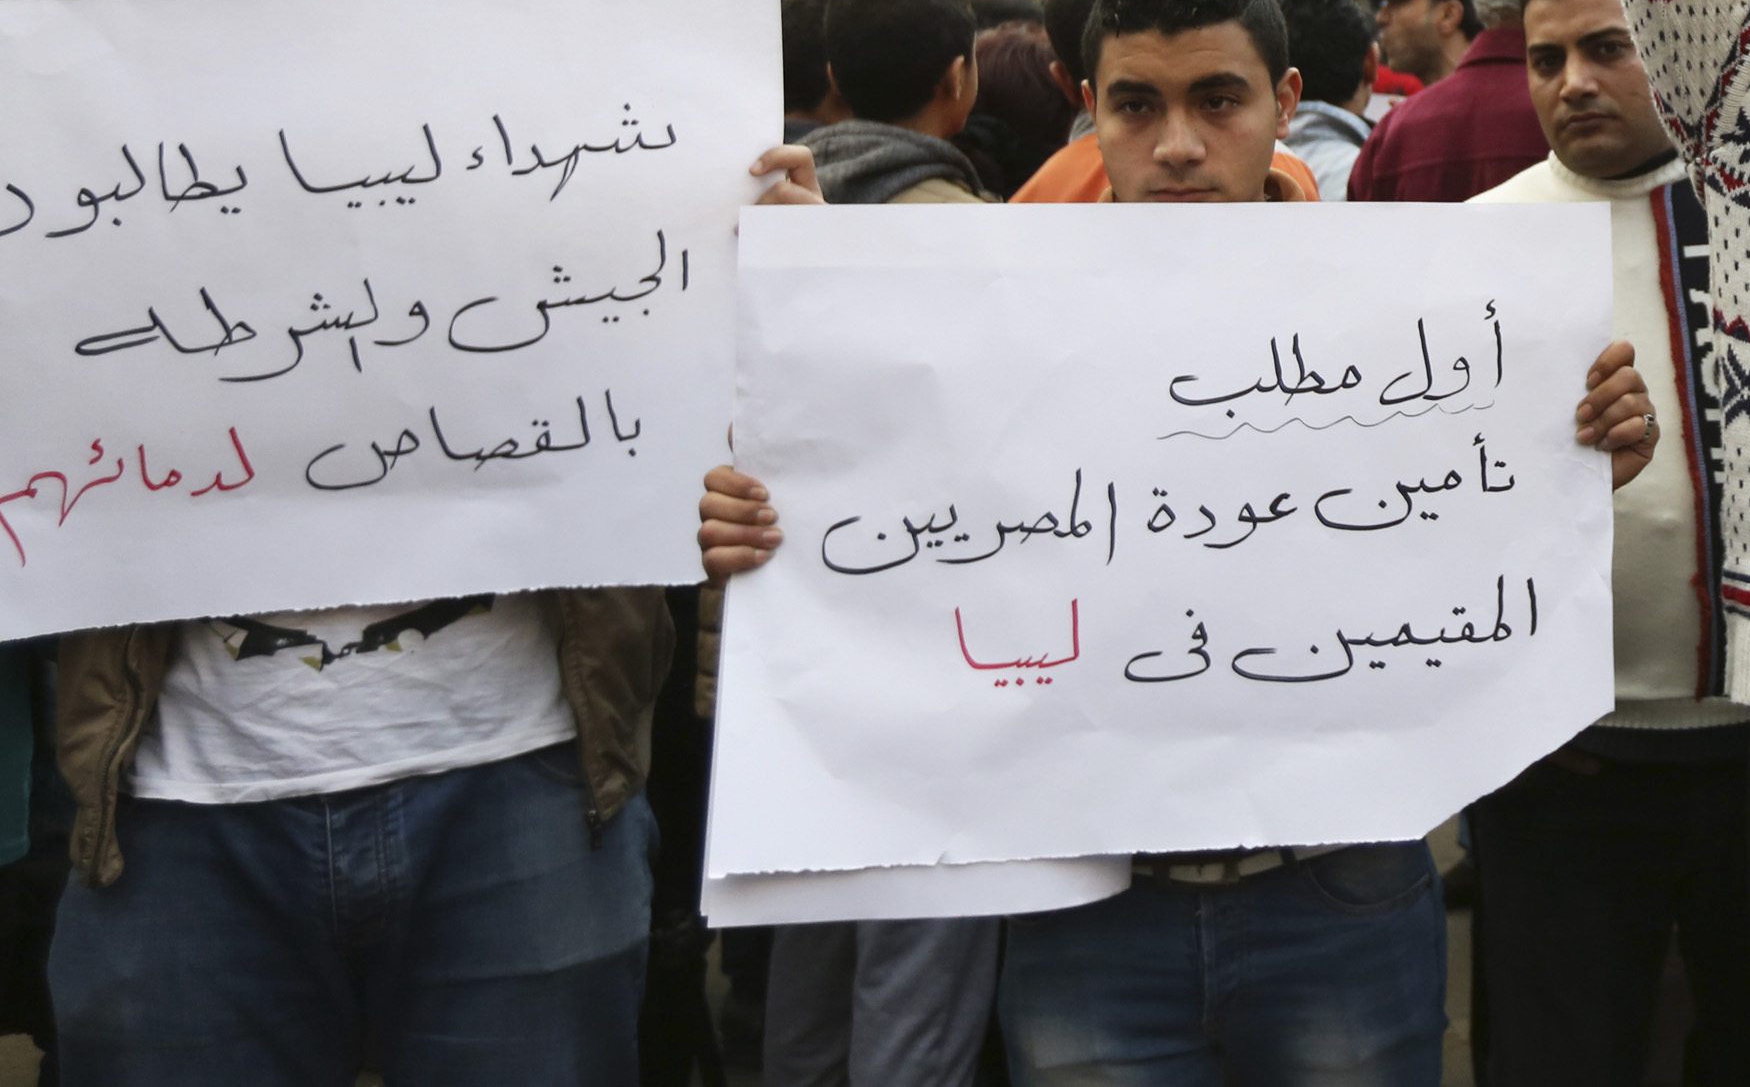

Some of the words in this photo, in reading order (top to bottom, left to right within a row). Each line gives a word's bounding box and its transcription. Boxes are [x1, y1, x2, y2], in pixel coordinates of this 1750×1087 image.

[279, 123, 441, 208] ليبيا
[466, 103, 676, 201] شهداء
[448, 230, 688, 353] الجيش
[1169, 333, 1362, 418] مطلب
[1379, 299, 1502, 405] أول
[305, 389, 640, 491] بالقصاص
[1314, 432, 1515, 531] تأمين
[822, 468, 1116, 575] المصريين
[1147, 487, 1297, 549] عودة
[955, 598, 1079, 687] ليبيا
[1231, 574, 1537, 683] المقيمين
